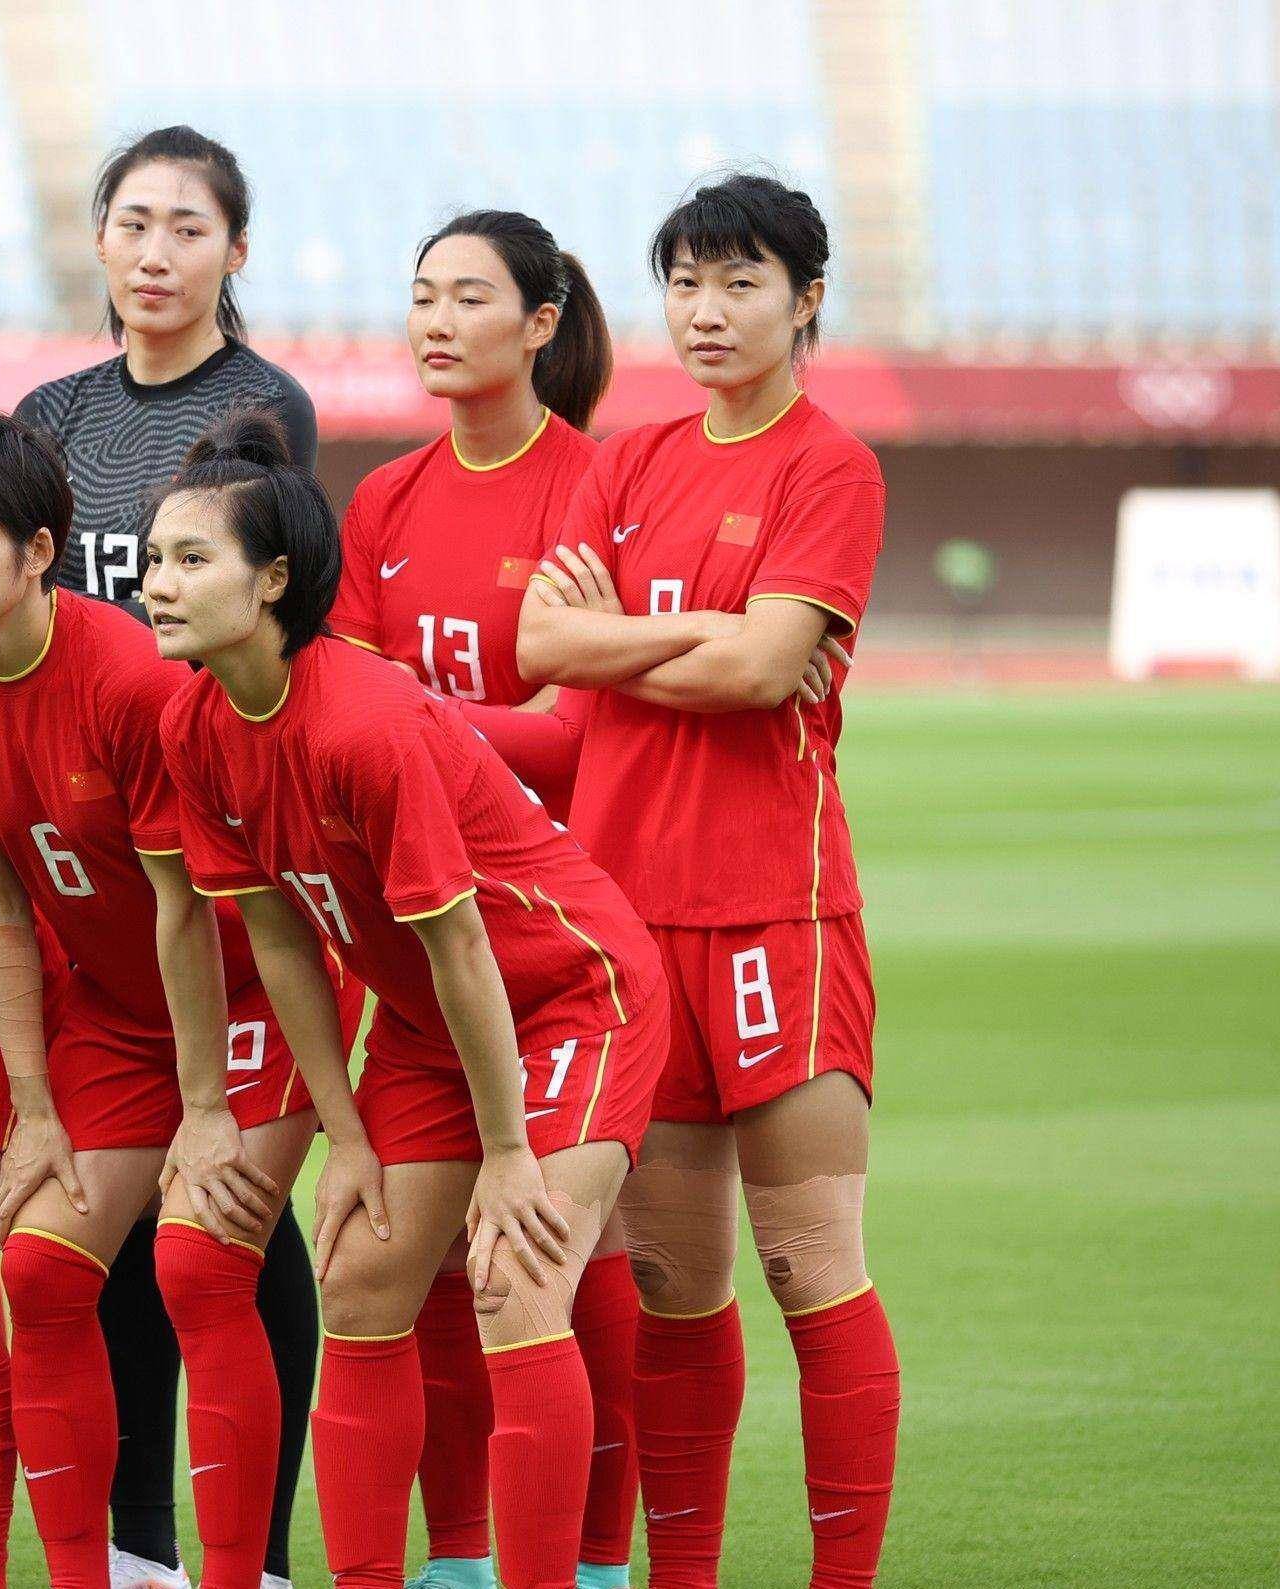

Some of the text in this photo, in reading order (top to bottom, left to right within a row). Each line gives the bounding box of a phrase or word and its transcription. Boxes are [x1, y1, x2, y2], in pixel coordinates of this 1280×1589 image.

[80, 532, 141, 600] 12
[418, 614, 486, 700] 13
[29, 822, 95, 897] 6
[280, 870, 354, 944] 17
[732, 946, 781, 1039] 8
